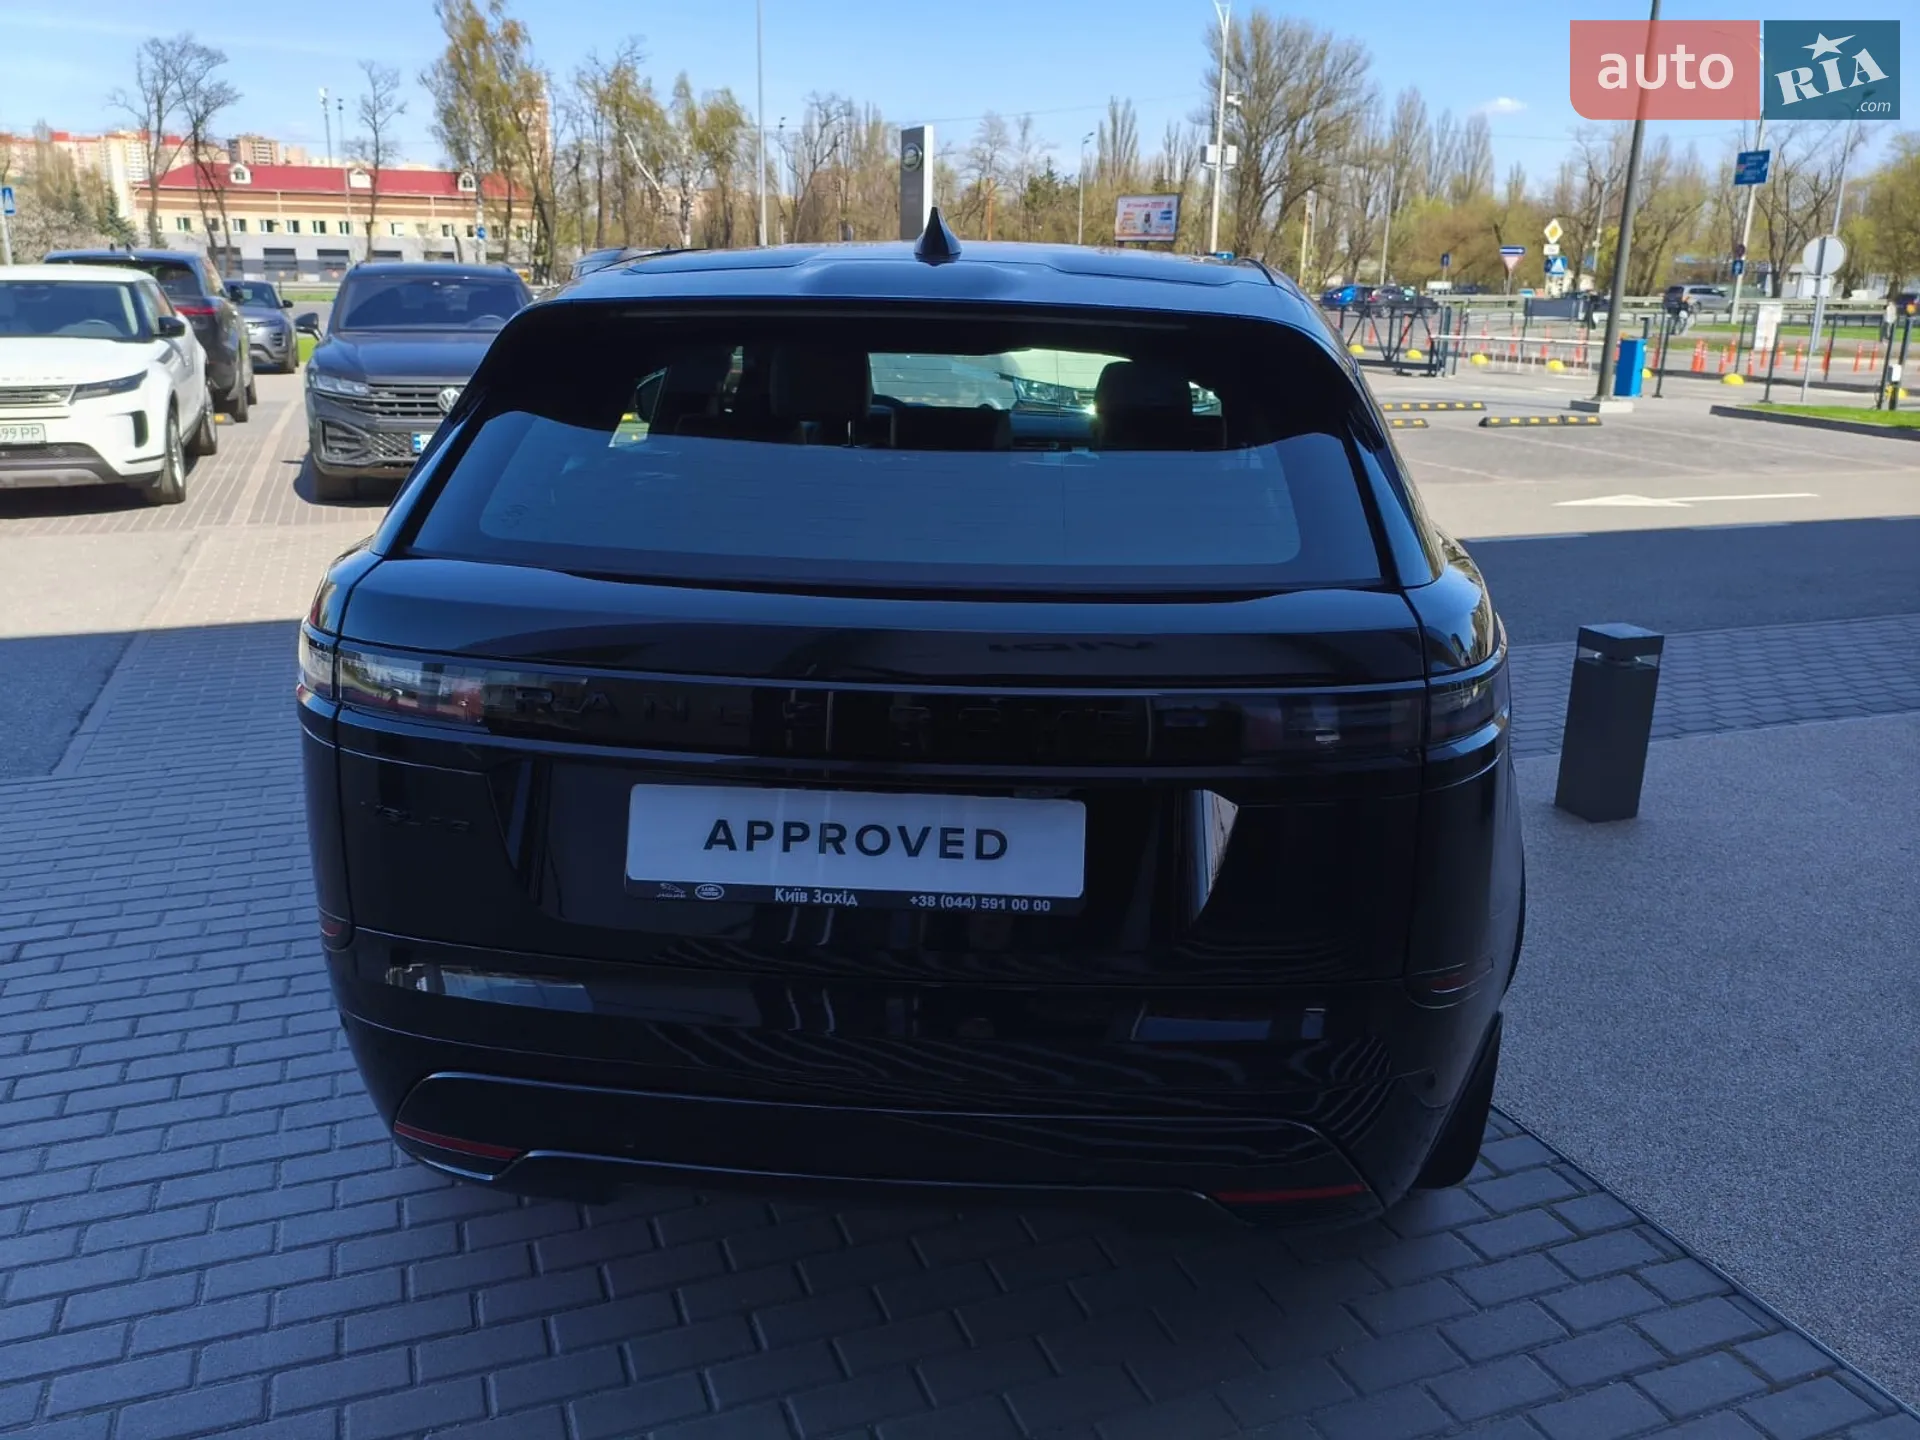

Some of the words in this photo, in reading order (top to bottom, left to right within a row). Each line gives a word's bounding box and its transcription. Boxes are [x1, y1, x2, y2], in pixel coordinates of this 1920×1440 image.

[0, 427, 17, 440] 99
[703, 819, 1008, 861] APPROVED
[775, 887, 808, 903] Київ
[813, 889, 858, 906] Захід
[910, 895, 936, 907] +38
[940, 894, 976, 909] (044)
[981, 897, 1006, 910] 591
[1011, 898, 1029, 911] 00
[1033, 900, 1051, 912] 00
